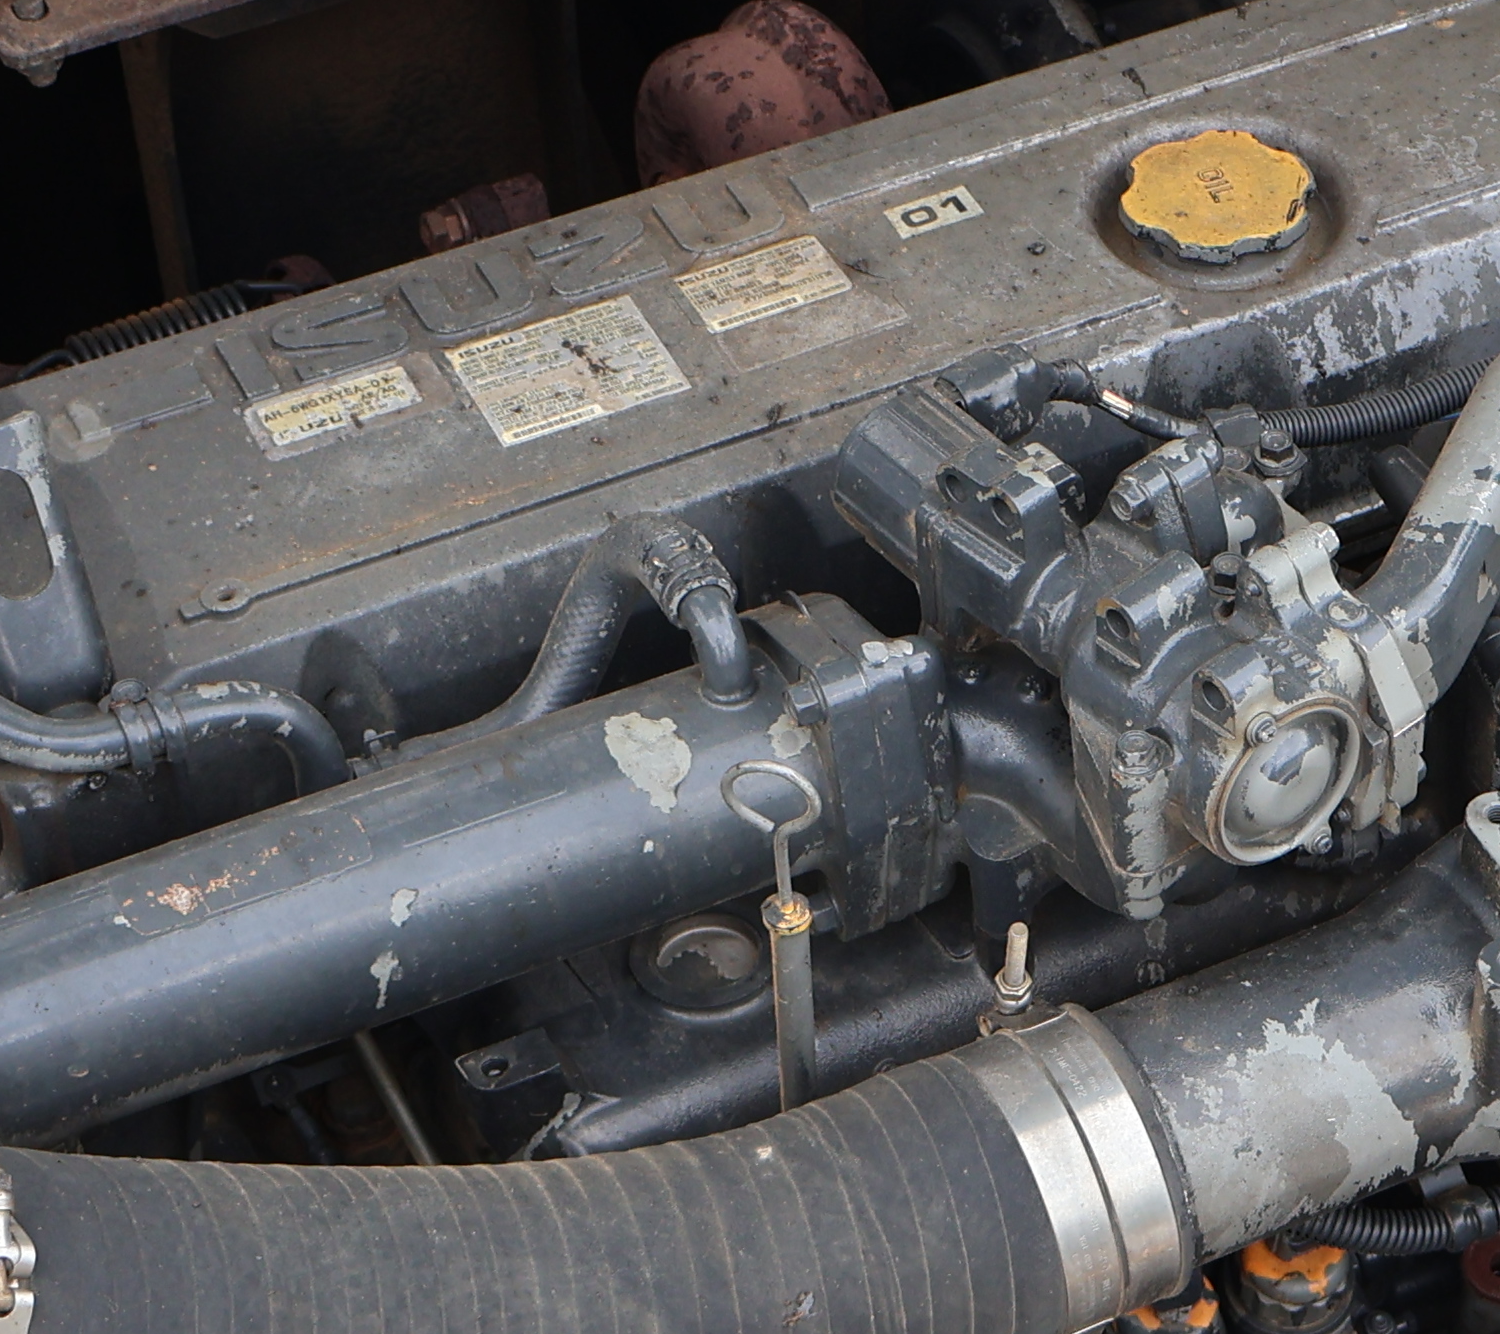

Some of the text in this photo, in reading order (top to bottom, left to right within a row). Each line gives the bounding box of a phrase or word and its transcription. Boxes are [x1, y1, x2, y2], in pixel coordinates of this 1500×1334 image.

[1196, 167, 1234, 204] OIL
[900, 195, 969, 229] 01
[214, 177, 786, 402] ISUZU
[457, 336, 515, 360] ISUZU
[278, 411, 344, 440] IUZU
